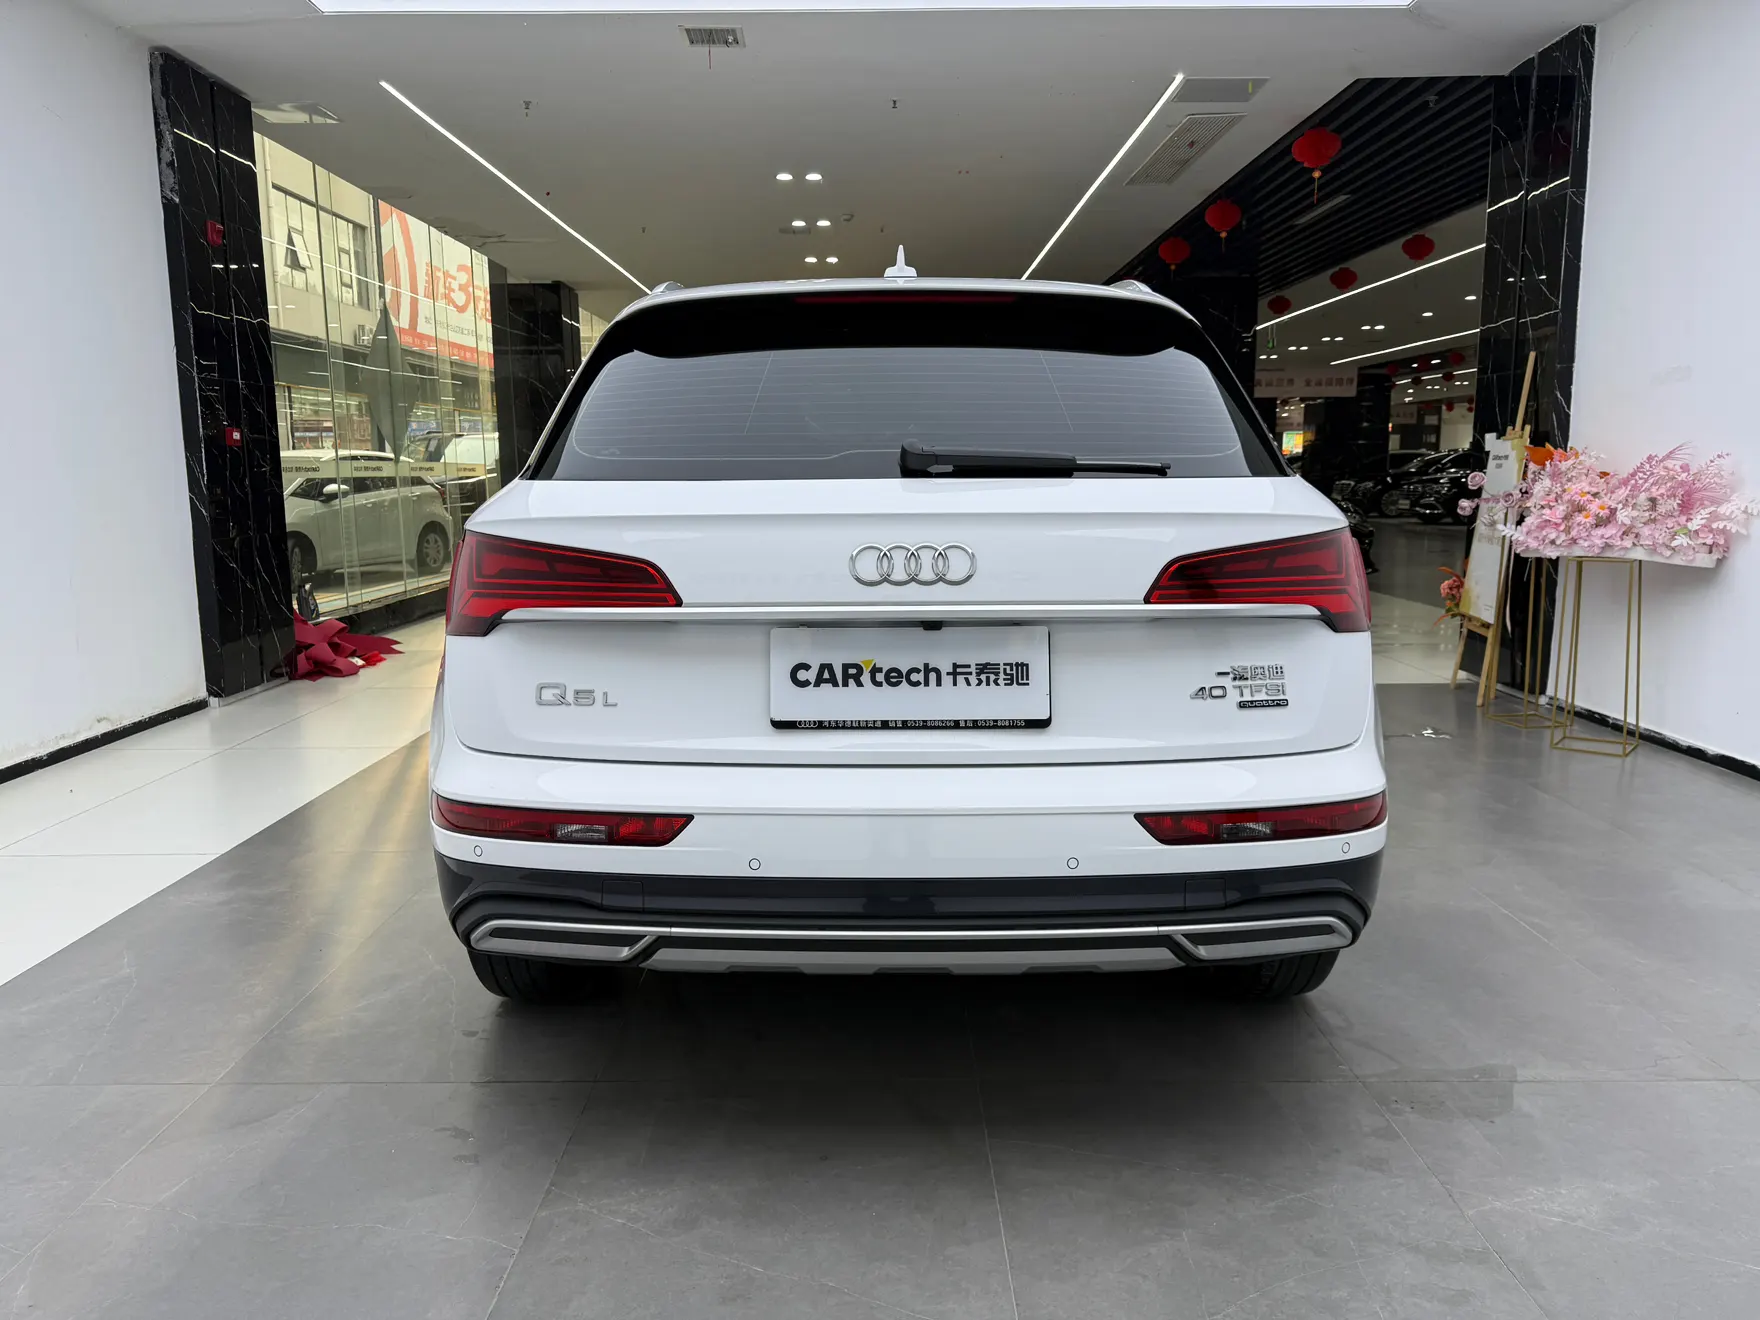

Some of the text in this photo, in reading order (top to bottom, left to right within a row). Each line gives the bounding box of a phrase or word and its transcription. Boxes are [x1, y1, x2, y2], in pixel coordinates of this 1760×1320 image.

[790, 661, 1030, 688] CARtech 卡泰驰
[1215, 663, 1285, 681] 一汽奥迪
[1190, 682, 1287, 700] 40 TFSI
[1239, 700, 1288, 708] quattro
